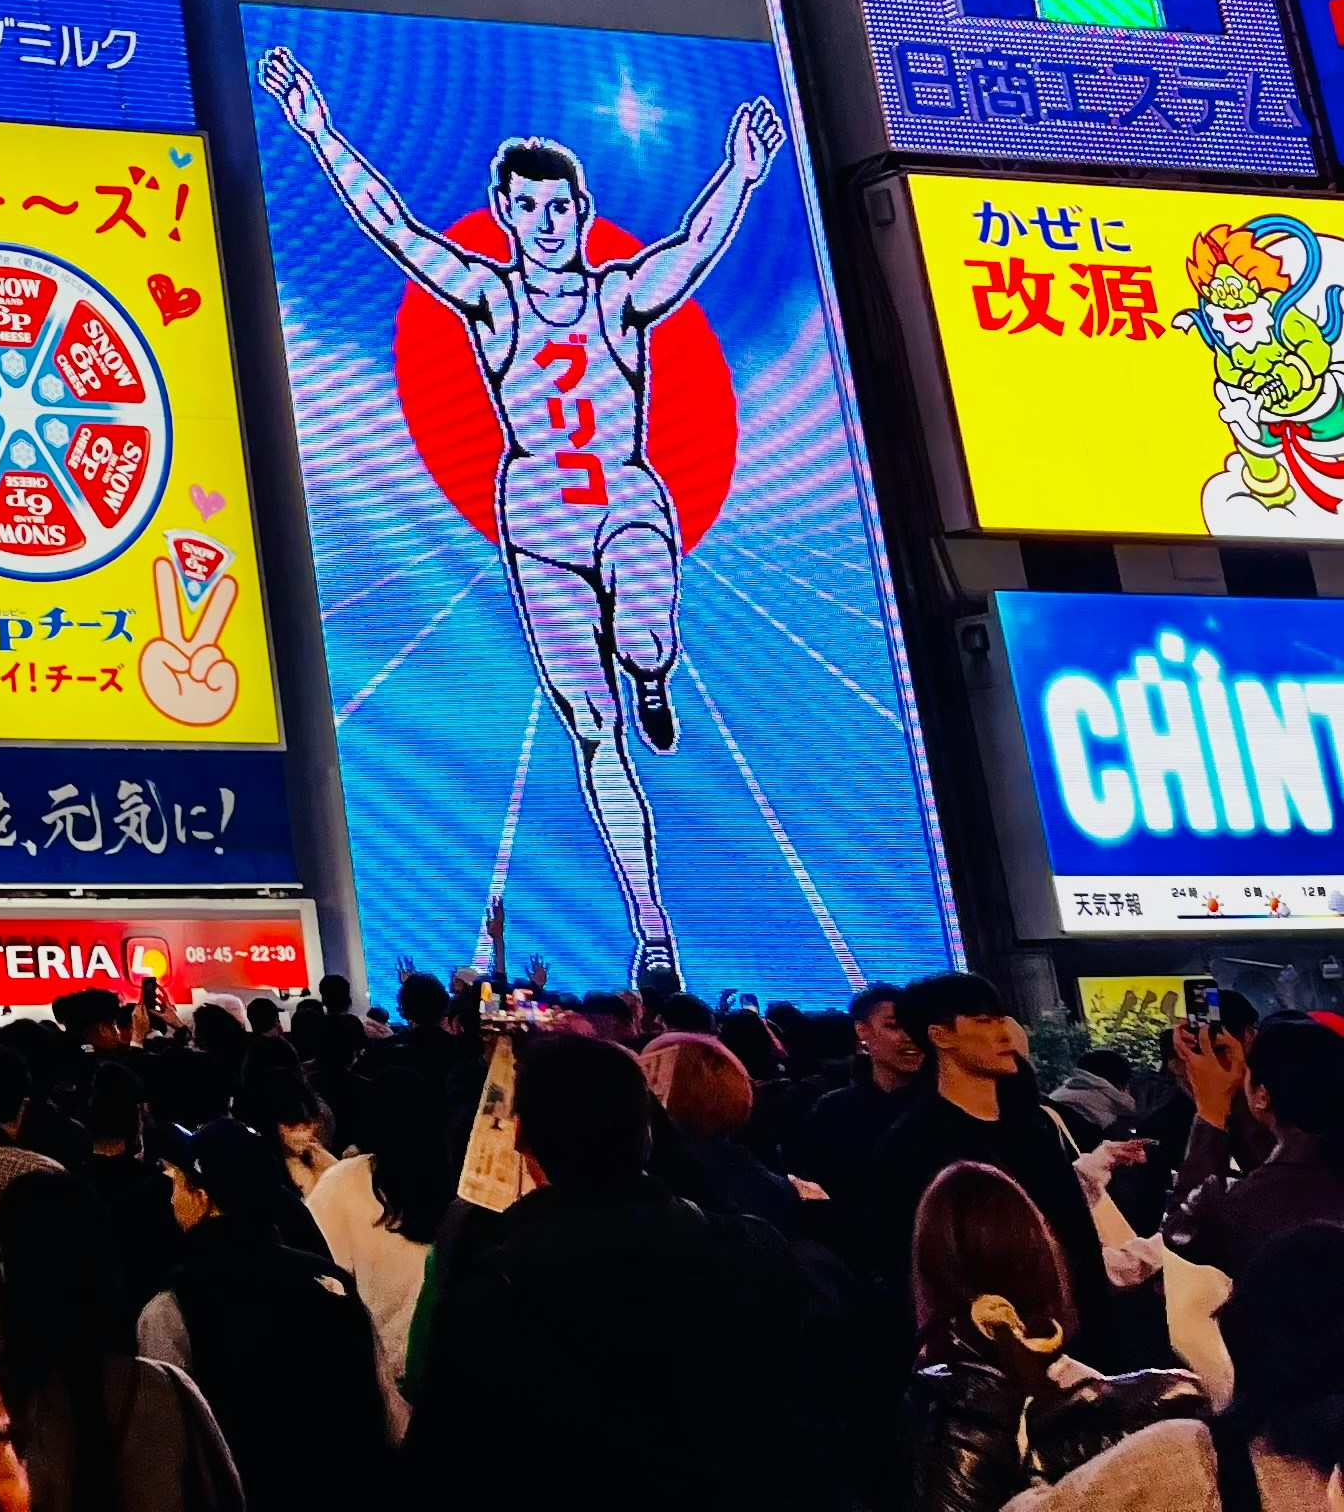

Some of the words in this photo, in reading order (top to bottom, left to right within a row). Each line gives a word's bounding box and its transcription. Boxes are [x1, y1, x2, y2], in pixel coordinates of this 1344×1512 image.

[891, 41, 1314, 137] 日商エステム
[972, 199, 1133, 254] かぜに
[963, 256, 1167, 342] 改源
[56, 353, 88, 398] CHEESE
[69, 342, 103, 391] 6P
[82, 318, 139, 388] SNOW
[532, 333, 609, 506] グリコ
[102, 439, 144, 516] SNOW
[1073, 892, 1144, 917] 天気予報
[1171, 886, 1199, 899] 24時
[1301, 886, 1327, 898] 12時
